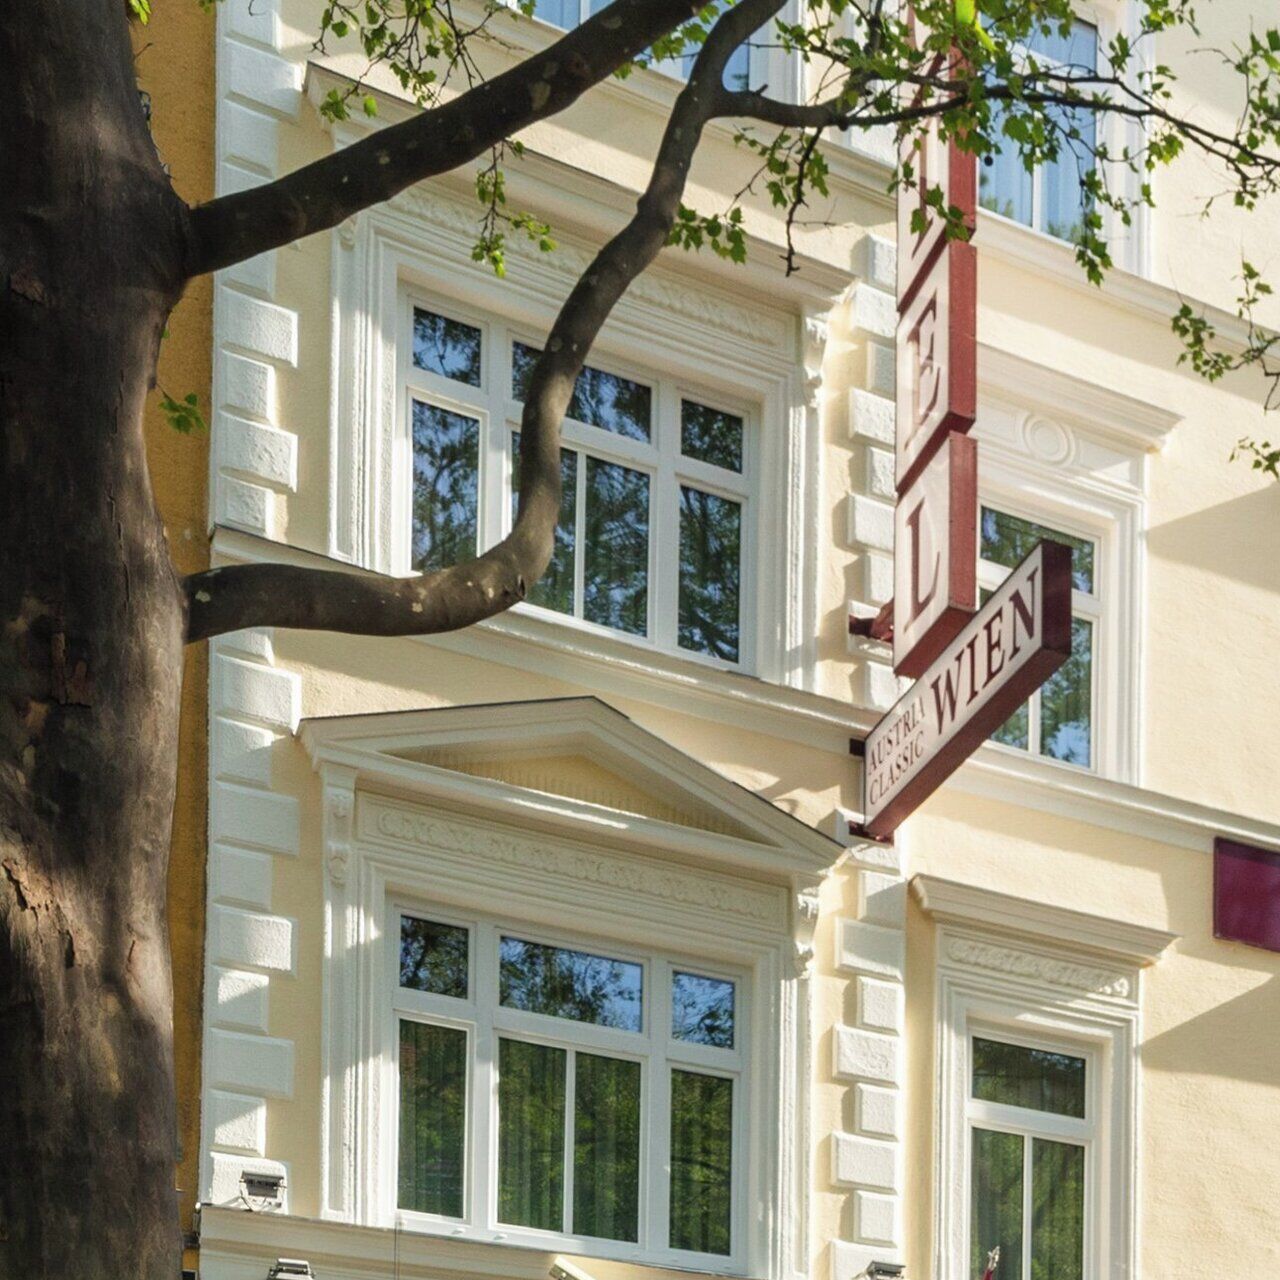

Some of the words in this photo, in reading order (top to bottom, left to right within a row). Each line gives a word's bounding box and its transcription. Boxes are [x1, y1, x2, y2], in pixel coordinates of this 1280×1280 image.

[931, 569, 1041, 737] WIEN
[868, 694, 926, 776] AUSTRIA
[870, 732, 925, 806] CLASSIC
